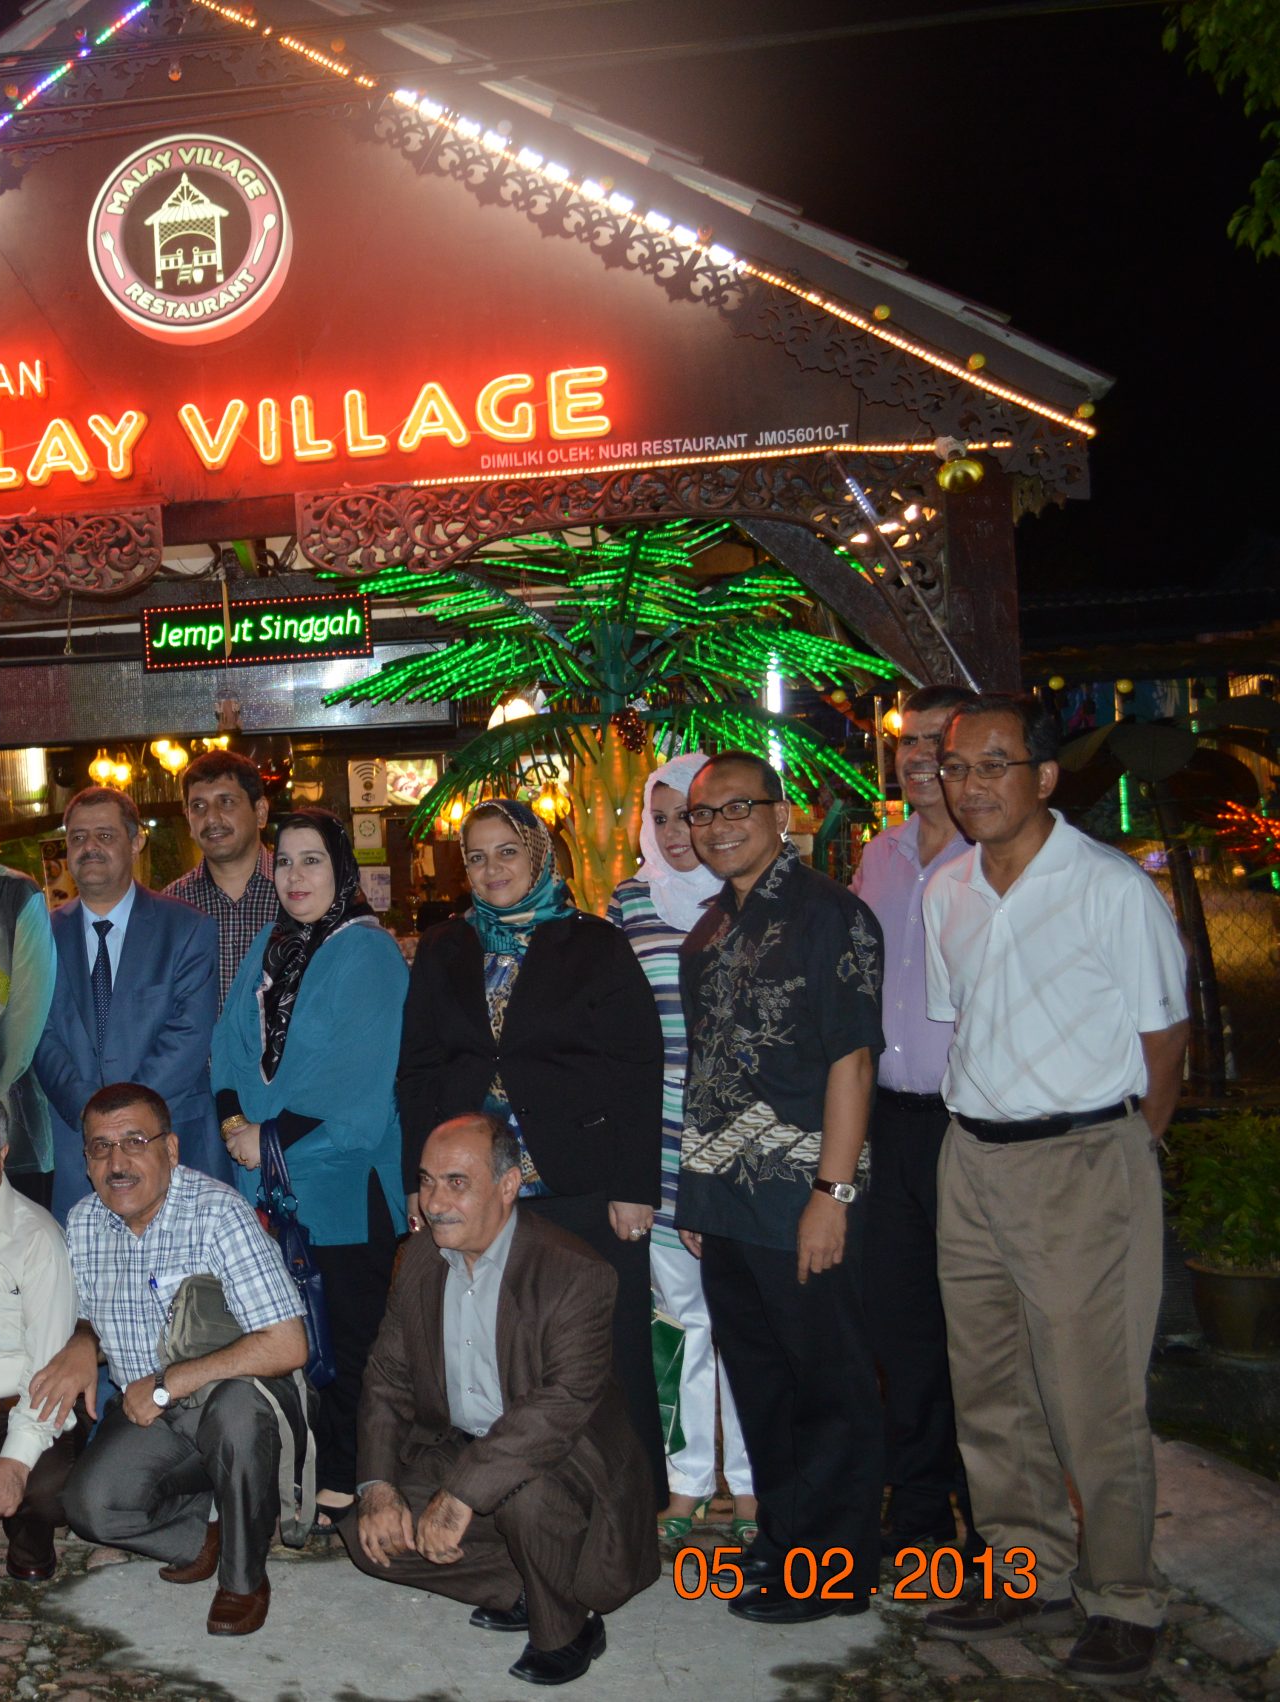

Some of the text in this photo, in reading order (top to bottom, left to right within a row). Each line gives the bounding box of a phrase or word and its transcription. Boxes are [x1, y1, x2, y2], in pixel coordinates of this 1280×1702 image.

[106, 147, 267, 215] MALAY VILLAGE
[124, 268, 255, 319] RESTAURANT
[178, 365, 611, 471] VILLAGE
[480, 423, 850, 470] DIMILIKI OLEH: NURI RESTAURANT JM056010-T
[259, 608, 361, 643] Singgah
